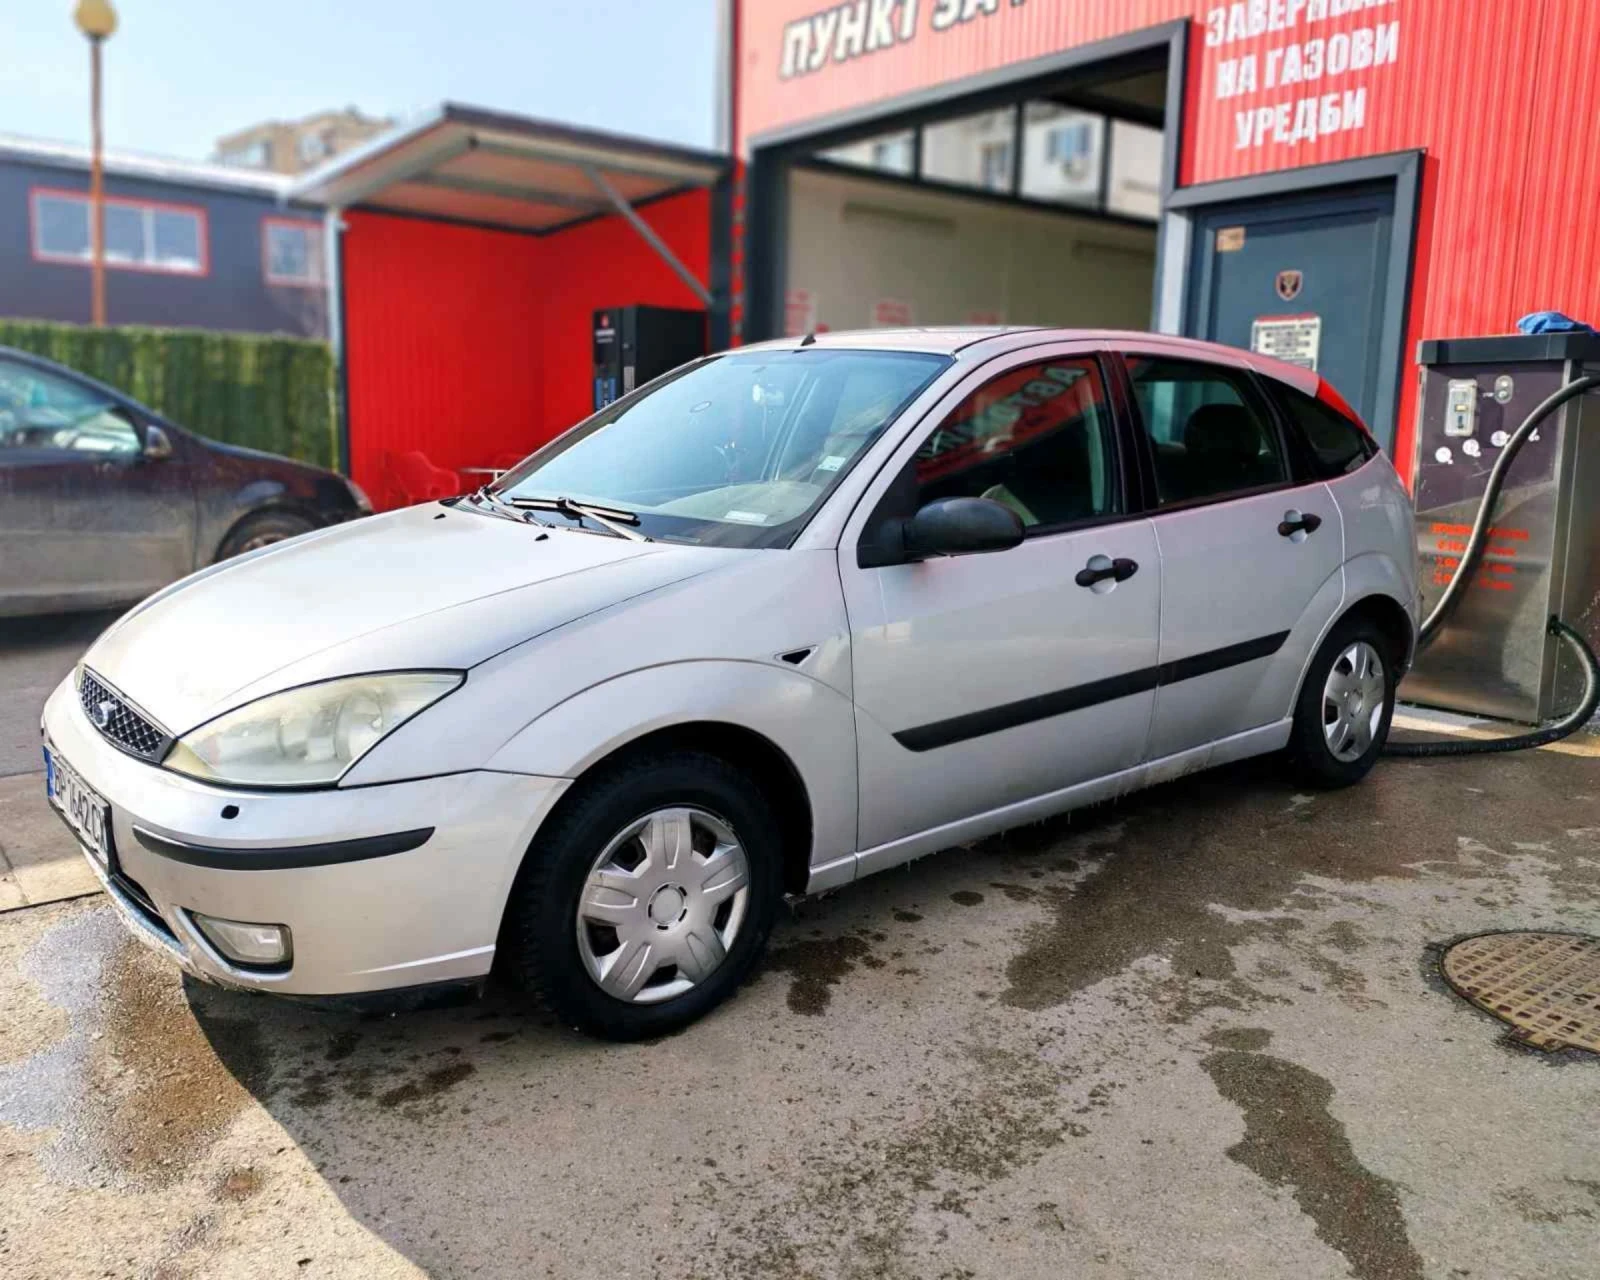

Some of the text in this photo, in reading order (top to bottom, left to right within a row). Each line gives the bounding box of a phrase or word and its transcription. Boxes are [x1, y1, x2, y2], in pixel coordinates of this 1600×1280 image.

[780, 0, 921, 82] ПУНКТ
[1215, 20, 1400, 99] НА ГАЗОВИ
[1234, 86, 1367, 150] УРЕДБИ
